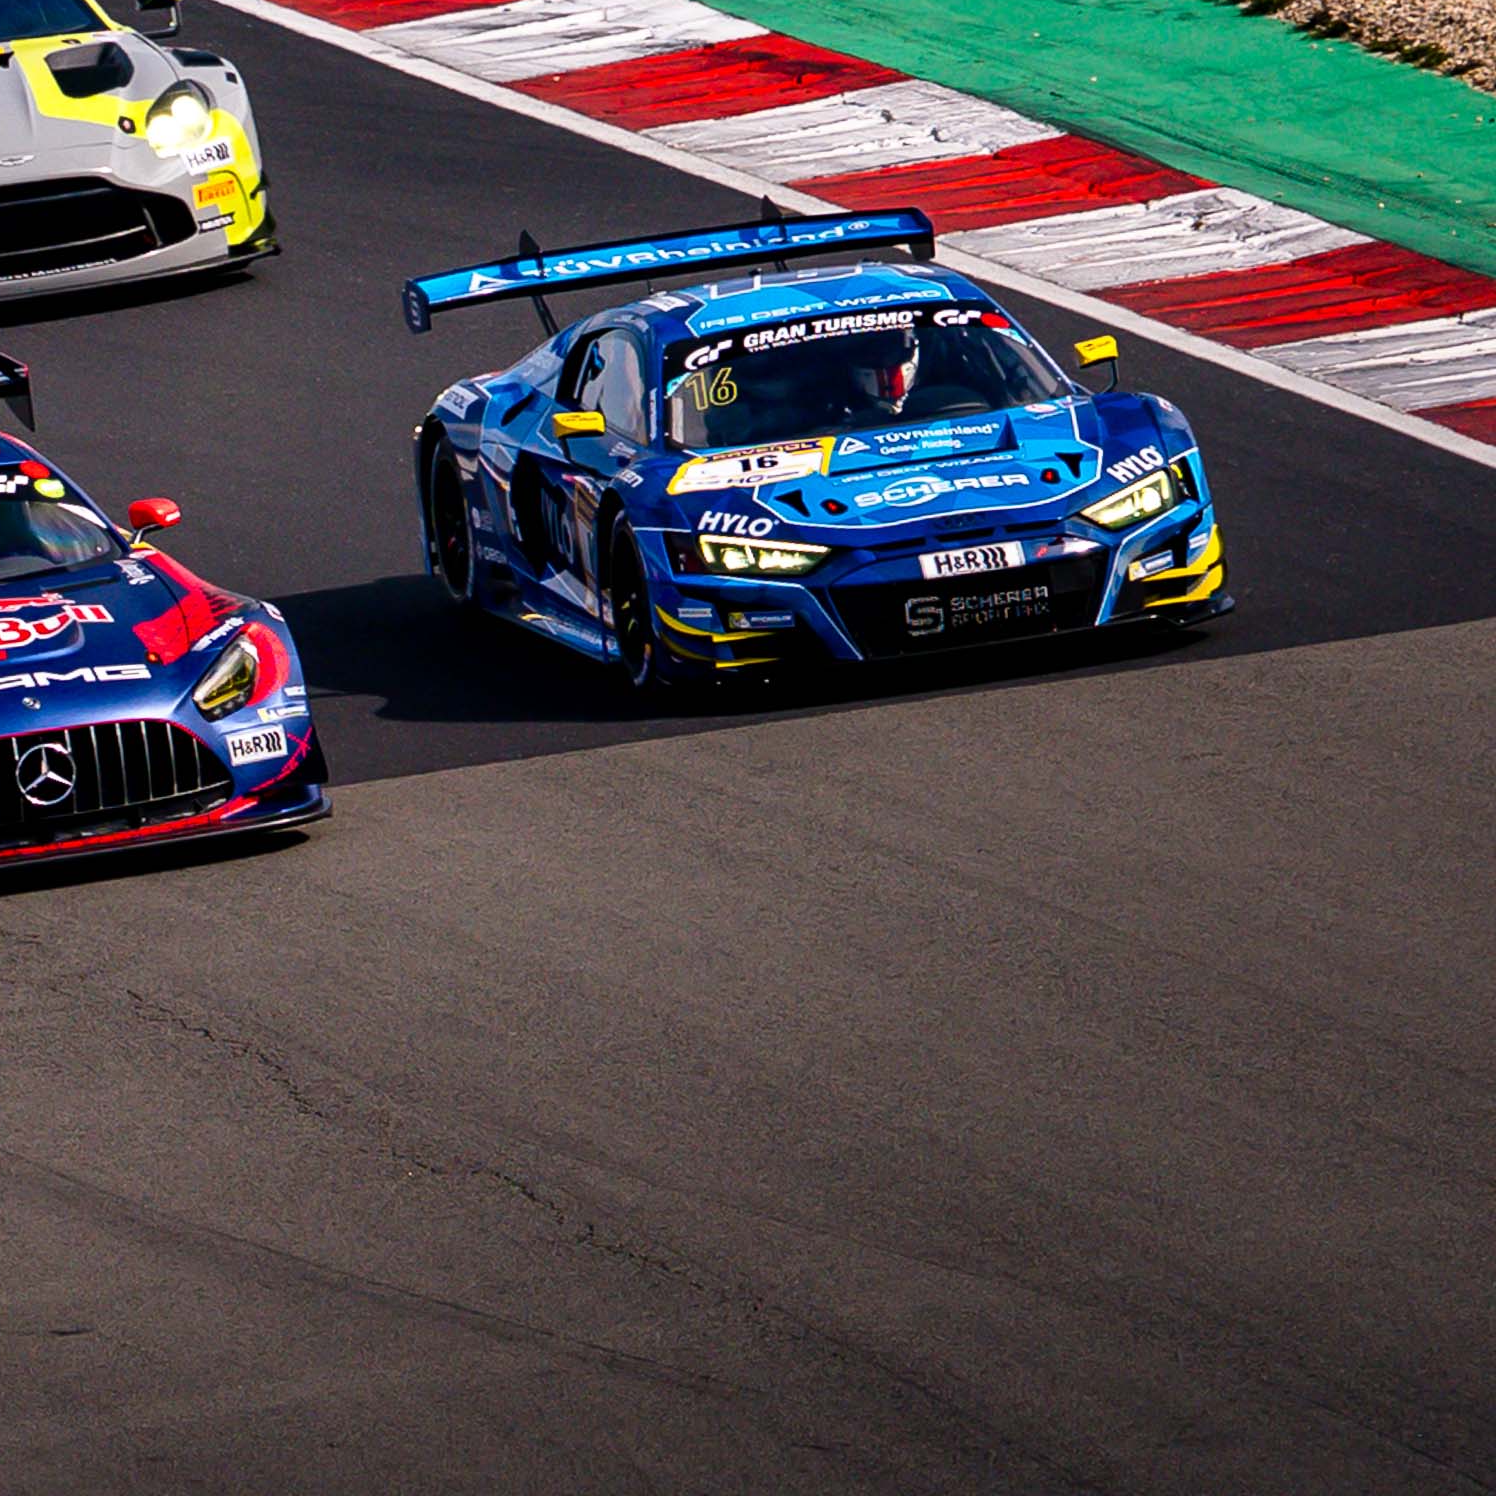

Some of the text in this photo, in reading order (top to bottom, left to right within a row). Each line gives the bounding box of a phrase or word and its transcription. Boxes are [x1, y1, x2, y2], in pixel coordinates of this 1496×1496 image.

[743, 310, 914, 349] GRAN TURISMO
[686, 365, 738, 412] 16
[736, 455, 780, 474] 16
[1106, 447, 1165, 484] HYLO
[853, 474, 1030, 509] SCHERER
[696, 511, 775, 538] HYLO
